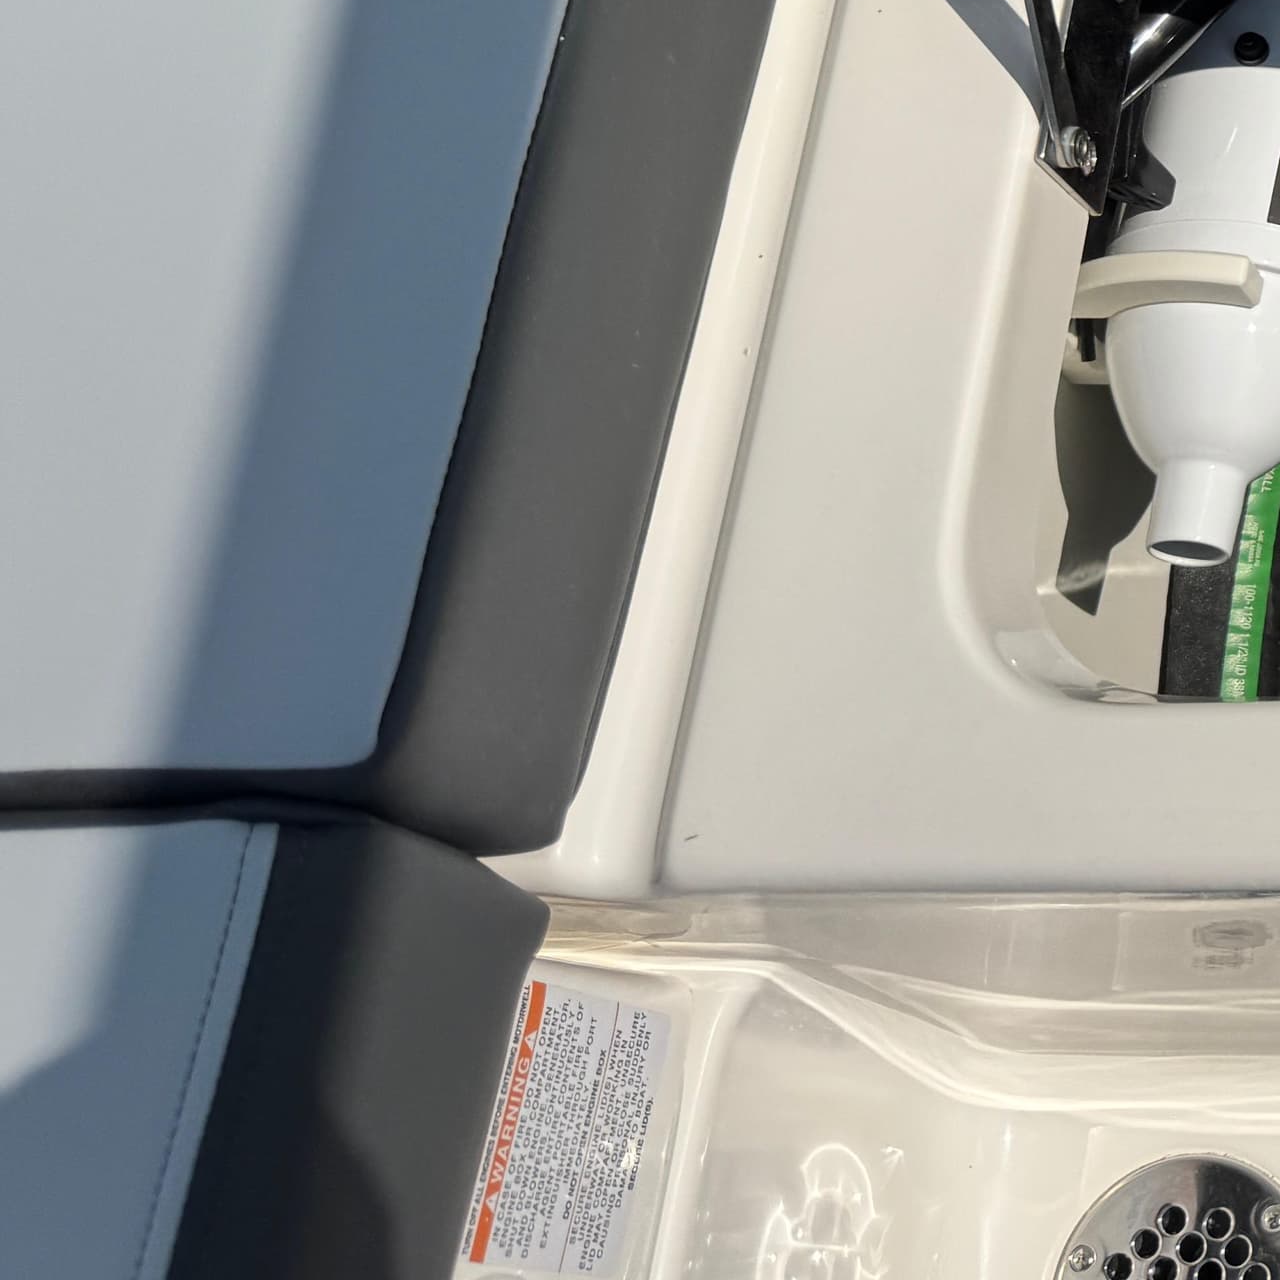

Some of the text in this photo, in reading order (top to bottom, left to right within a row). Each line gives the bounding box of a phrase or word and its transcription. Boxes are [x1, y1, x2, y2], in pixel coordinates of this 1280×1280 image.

[489, 1055, 530, 1184] WARNING
[491, 1005, 553, 1242] IN CASE OF FIRE DO NOT OPEN
[498, 1190, 517, 1248] ENGINE
[513, 1153, 526, 1184] BOX
[522, 1126, 532, 1148] OR
[504, 1218, 519, 1258] SHUT
[515, 1165, 532, 1211] DOWN
[515, 1215, 528, 1246] AND
[544, 1010, 576, 1125] CONTINUOUSLY
[520, 1001, 586, 1258] DISCHARGE ENTIRE CONTENTS OF
[539, 1045, 584, 1216] AGENT PORTABLE FIRE
[539, 1016, 598, 1248] EXTINGUISHER THROUGH PORT
[562, 1048, 606, 1219] DO NOT OPEN ENGINE BOX
[568, 1184, 587, 1244] SECURE
[584, 1123, 601, 1178] ENGINE
[608, 1029, 622, 1070] WHEN
[577, 1039, 627, 1240] UNDERWAY OR WORKING IN
[578, 1214, 596, 1270] ENGINE
[618, 1011, 641, 1087] UNSECURE
[585, 1011, 648, 1271] LID MAY OPEN OR CLOSE SUDDENLY
[595, 1192, 616, 1258] CAUSING
[629, 1054, 646, 1105] INJURY
[642, 1030, 652, 1050] OR
